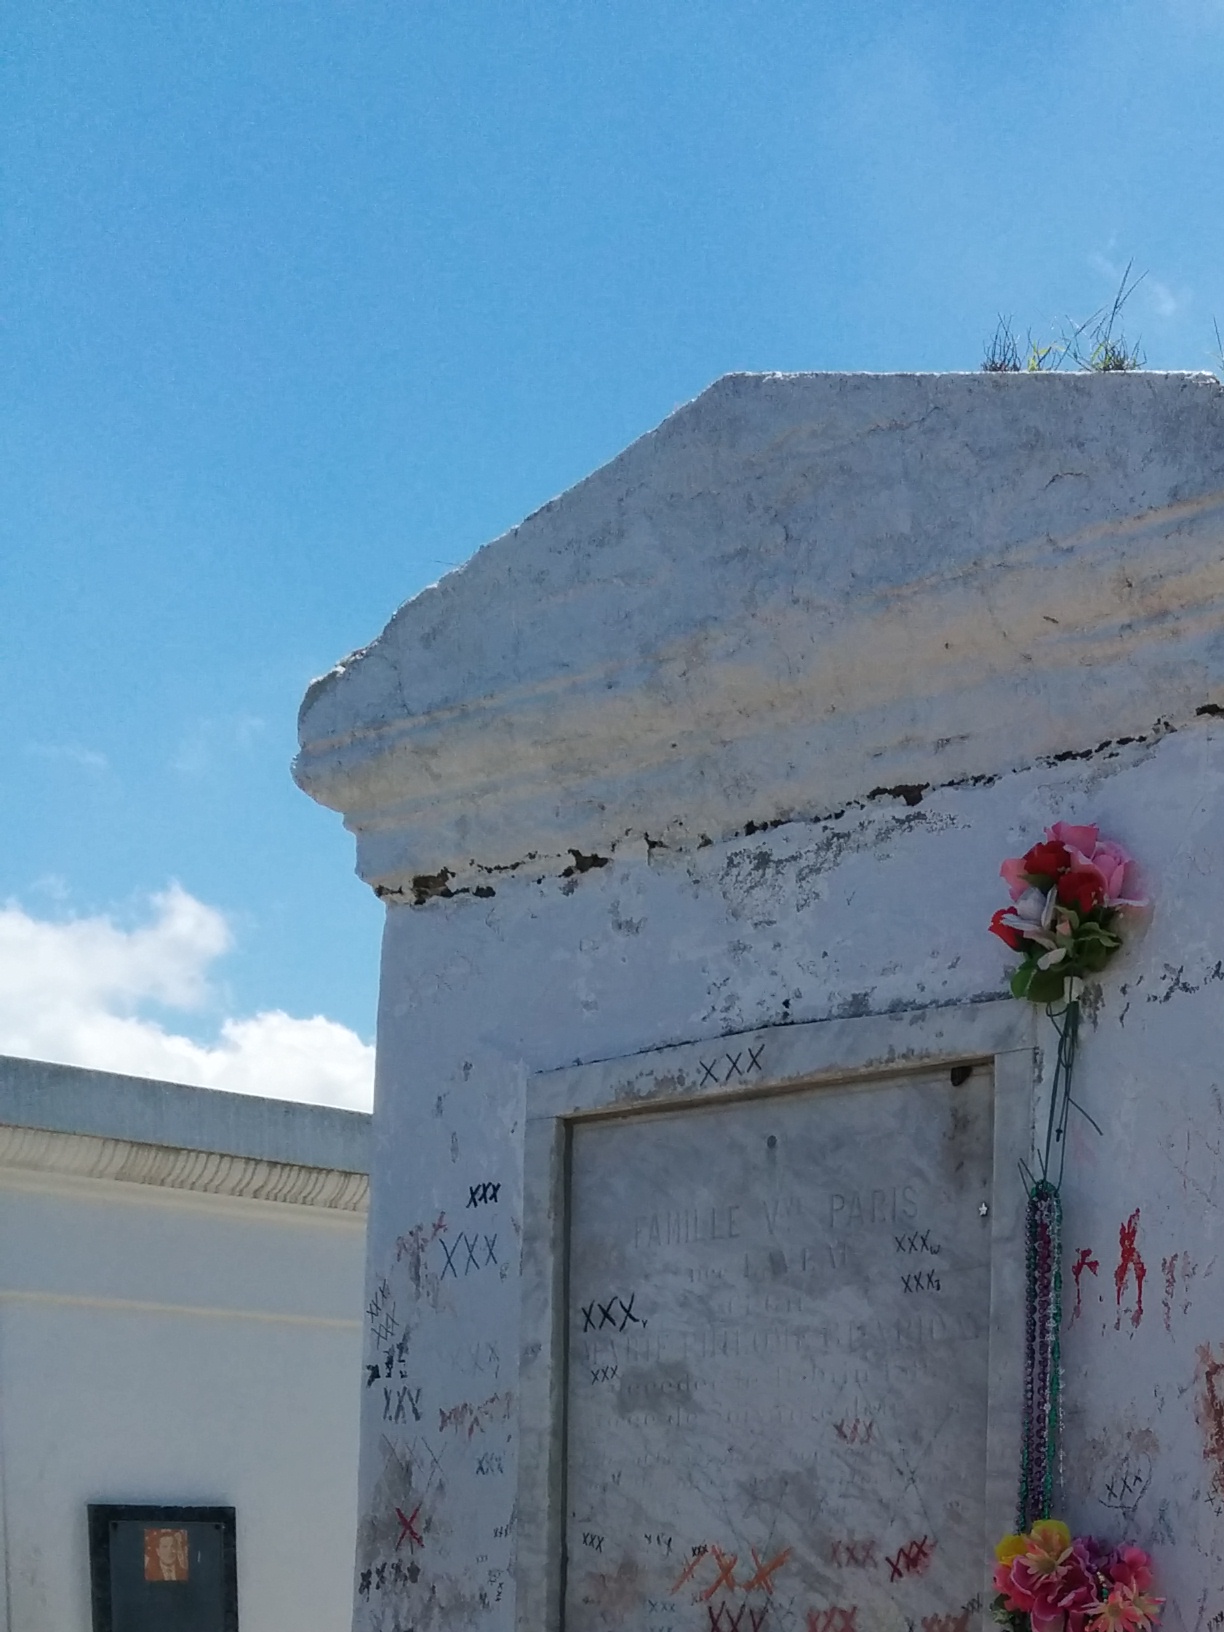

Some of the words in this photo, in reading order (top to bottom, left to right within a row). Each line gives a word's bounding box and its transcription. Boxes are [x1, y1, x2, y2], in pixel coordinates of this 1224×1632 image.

[700, 1044, 765, 1086] XXX
[466, 1182, 500, 1208] XXX
[634, 1205, 741, 1249] FAMILLE
[829, 1184, 919, 1230] PARIS
[439, 1231, 497, 1280] XXX
[591, 1365, 619, 1386] XXX
[582, 1532, 605, 1554] XXX
